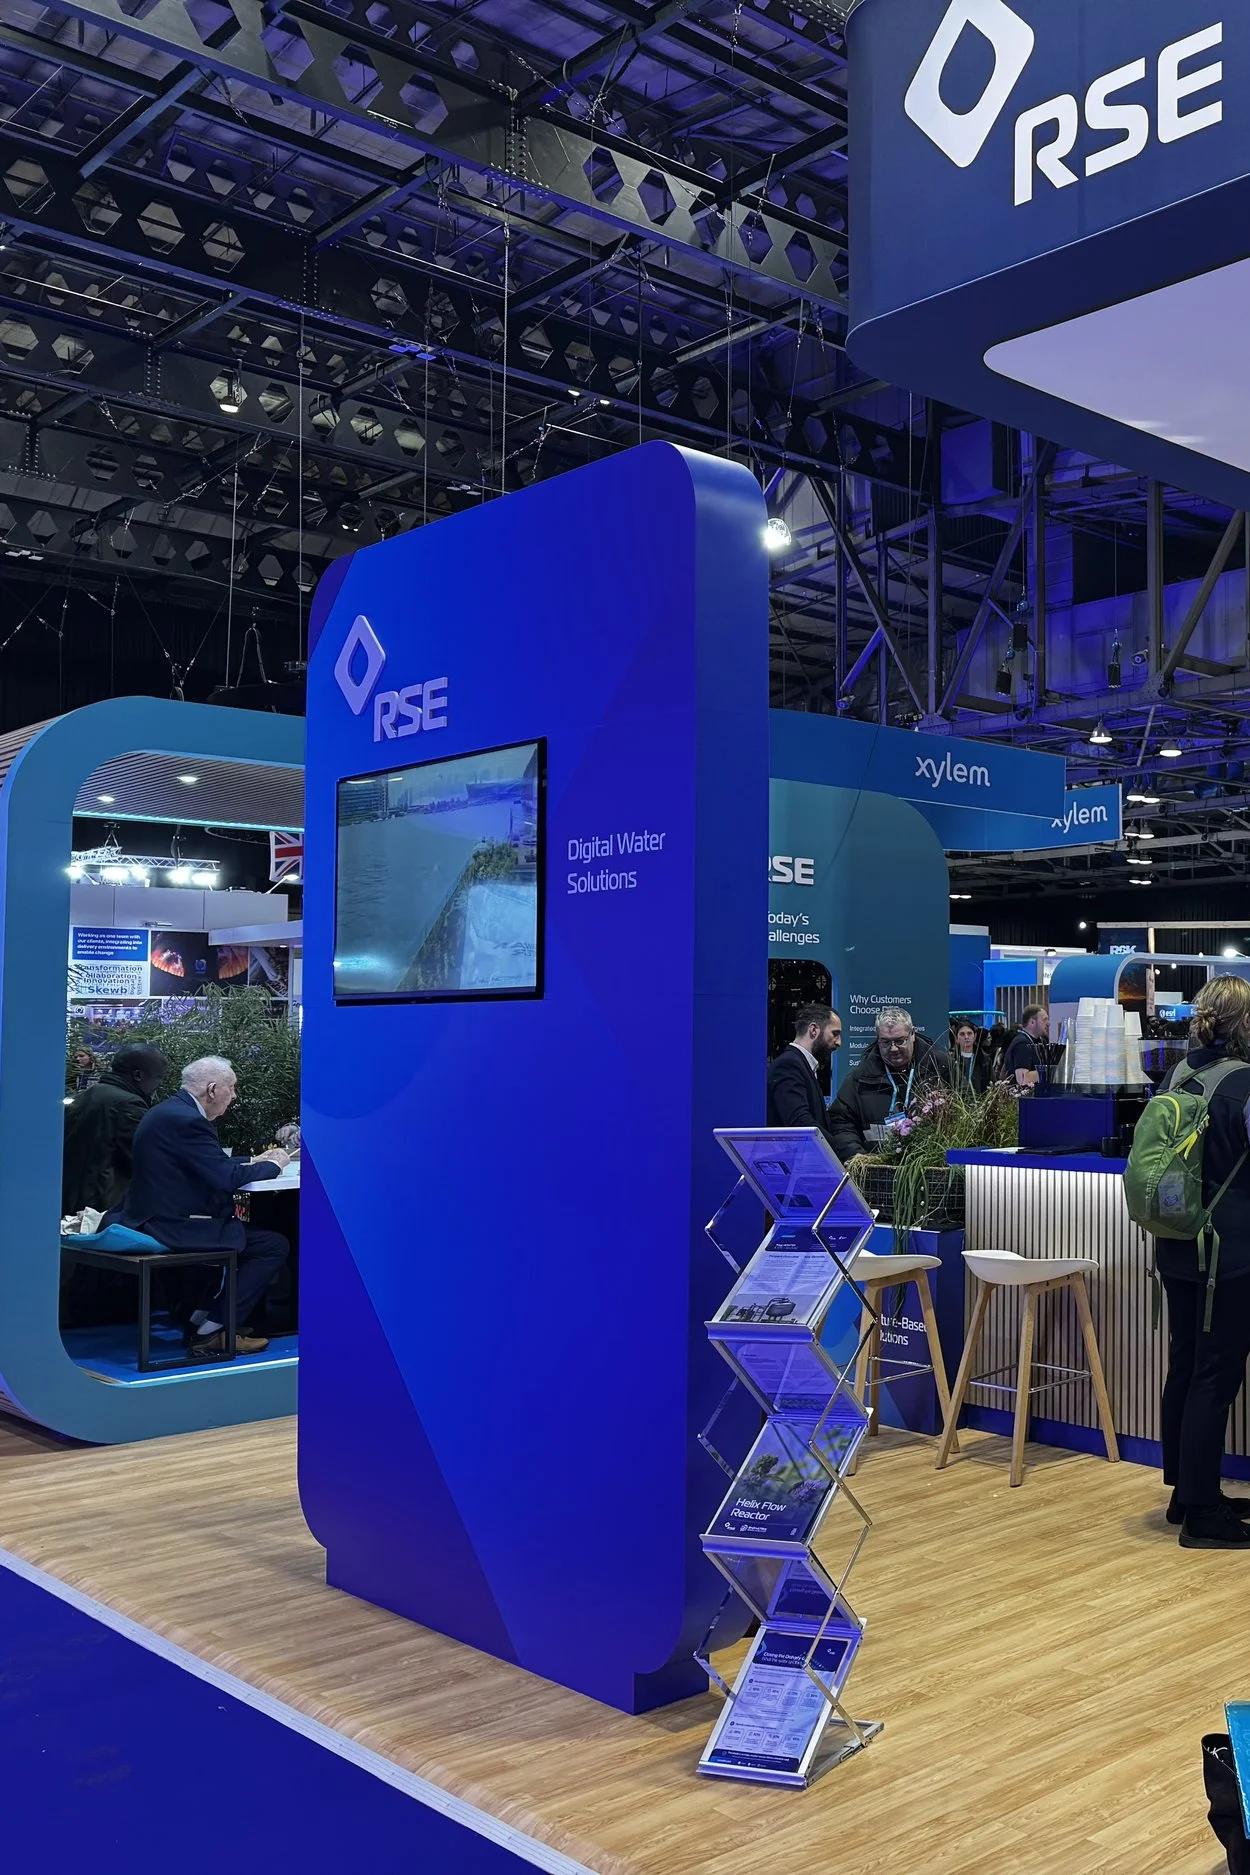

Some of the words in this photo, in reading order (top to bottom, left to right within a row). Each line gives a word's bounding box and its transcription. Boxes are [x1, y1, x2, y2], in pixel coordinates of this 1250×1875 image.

[1014, 21, 1223, 207] RSE
[374, 676, 448, 742] RSE
[915, 752, 990, 788] xylem
[567, 834, 613, 864] Digital
[616, 830, 666, 855] Water
[768, 855, 815, 885] SE
[567, 869, 638, 895] Solutions
[768, 911, 810, 927] oday's
[768, 929, 820, 945] allenges
[88, 985, 128, 994] Skewb
[849, 994, 869, 1004] Why
[870, 994, 912, 1004] Customers
[849, 1005, 881, 1015] Choose
[1165, 1008, 1176, 1017] esri
[880, 1313, 927, 1333] tue-Base
[880, 1329, 909, 1346] lutions
[735, 1497, 760, 1509] Helix
[761, 1501, 787, 1512] Flow
[730, 1507, 771, 1521] Reactor
